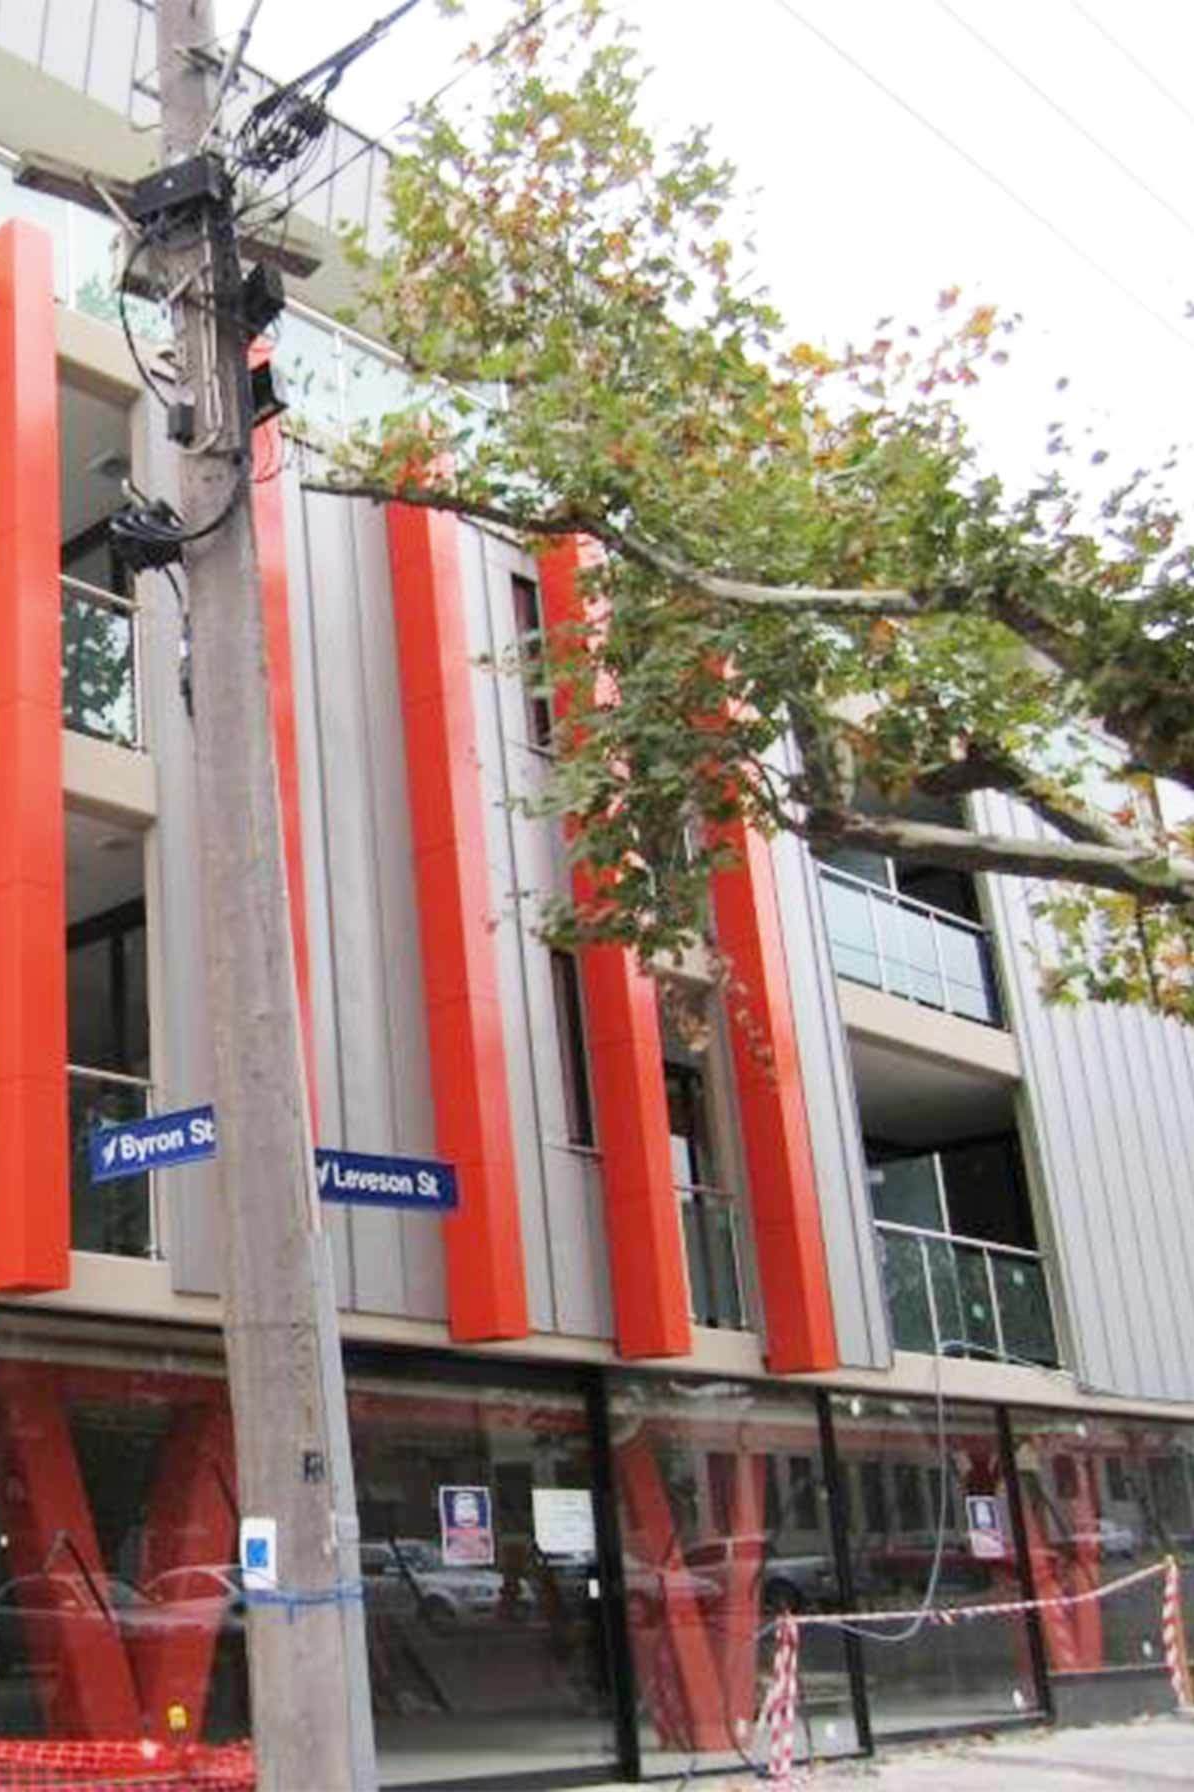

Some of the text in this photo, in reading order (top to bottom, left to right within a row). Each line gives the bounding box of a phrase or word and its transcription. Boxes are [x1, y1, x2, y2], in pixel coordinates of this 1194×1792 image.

[120, 1119, 215, 1161] Byron St
[333, 1161, 439, 1196] Leveson St
